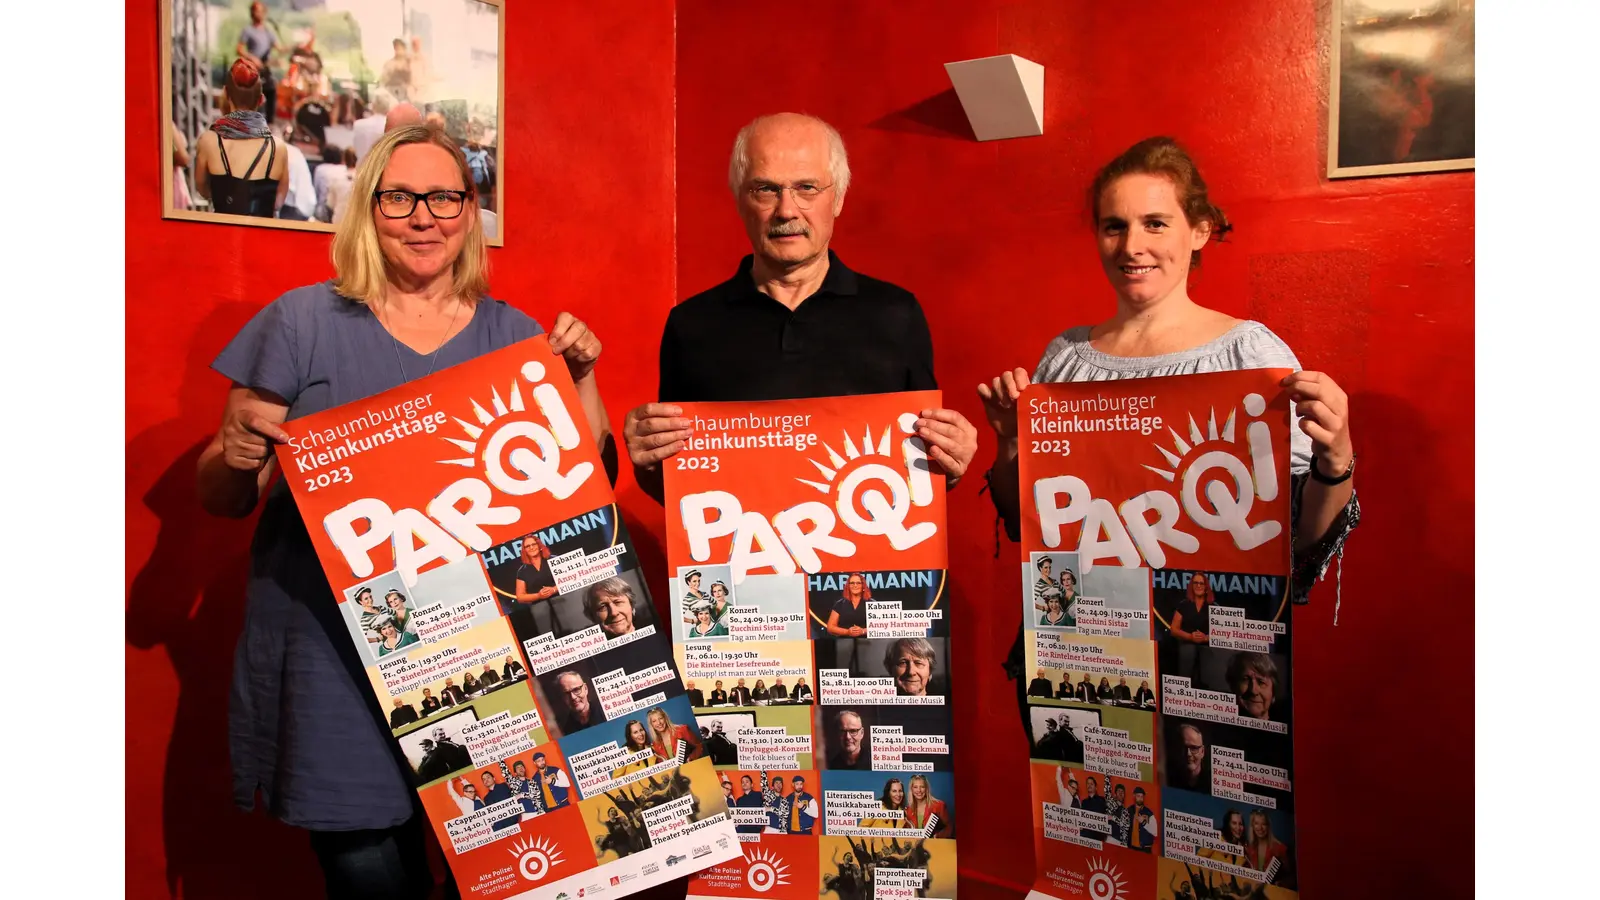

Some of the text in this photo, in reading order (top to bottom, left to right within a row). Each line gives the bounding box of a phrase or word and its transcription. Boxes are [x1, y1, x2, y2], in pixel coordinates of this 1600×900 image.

[1030, 394, 1156, 414] Schaumburger
[288, 394, 431, 453] Schaumburger
[688, 413, 812, 432] haumburger
[1031, 415, 1162, 434] Kleinkunsttage
[296, 412, 445, 471] Kleinkunsttage
[681, 431, 818, 452] leinkunsttage
[1031, 440, 1069, 456] 2023
[677, 456, 719, 472] 2023
[305, 466, 352, 491] 2023
[549, 551, 582, 566] Kabarett
[567, 562, 583, 570] 11.11.
[588, 552, 608, 563] 20.00
[609, 546, 623, 555] Uhr
[557, 559, 616, 584] Anny Hartmann
[411, 603, 442, 618] Konzert
[429, 611, 452, 622] 24.09.
[456, 601, 475, 612] 19.30
[476, 595, 490, 604] Uhr
[1077, 598, 1103, 606] Konzert
[1077, 616, 1106, 625] Zucchini
[1210, 607, 1242, 617] Kabarett
[418, 611, 474, 635] Zucchini Sistaz
[1268, 624, 1283, 632] Uhr
[526, 635, 553, 648] Lesung
[542, 643, 560, 652] 18.11.
[564, 633, 584, 644] 20.00
[584, 628, 598, 636] Uhr
[1037, 632, 1060, 641] Lesung
[1211, 628, 1272, 641] Anny Hartmann
[532, 655, 551, 665] Peter
[551, 646, 575, 658] Urban
[593, 635, 604, 643] Air
[1050, 651, 1080, 660] Rintelner
[1082, 654, 1123, 665] Lesefreunde
[594, 670, 622, 685] Konzert
[600, 673, 673, 702] Reinhold Beckmann
[612, 696, 631, 707] Band
[461, 712, 509, 734] Café-Konzert
[1084, 726, 1126, 738] Café-Konzert
[468, 720, 540, 750] Unplugged-Konzert
[570, 744, 616, 763] Literarisches
[574, 749, 627, 772] Musikkabarett
[1213, 747, 1242, 759] Konzert
[580, 774, 608, 789] DULABI
[583, 760, 676, 797] Swingende Weihnachtszeit
[1213, 767, 1289, 789] Reinhold Beckmann
[447, 799, 515, 828] A-Cappella Konzert
[643, 798, 690, 818] Improtheater
[646, 808, 690, 827] Datum Uhr
[1044, 803, 1106, 822] A-Cappella Konzert
[649, 818, 686, 836] Spek Spek
[1166, 810, 1211, 827] Literarisches
[453, 827, 490, 844] Maybebop
[652, 816, 724, 845] Theater Spektakulär
[1166, 821, 1219, 839] Musikkabarett
[1166, 840, 1193, 853] DULABI
[876, 869, 924, 878] Improtheater
[876, 888, 912, 897] Spek Spek
